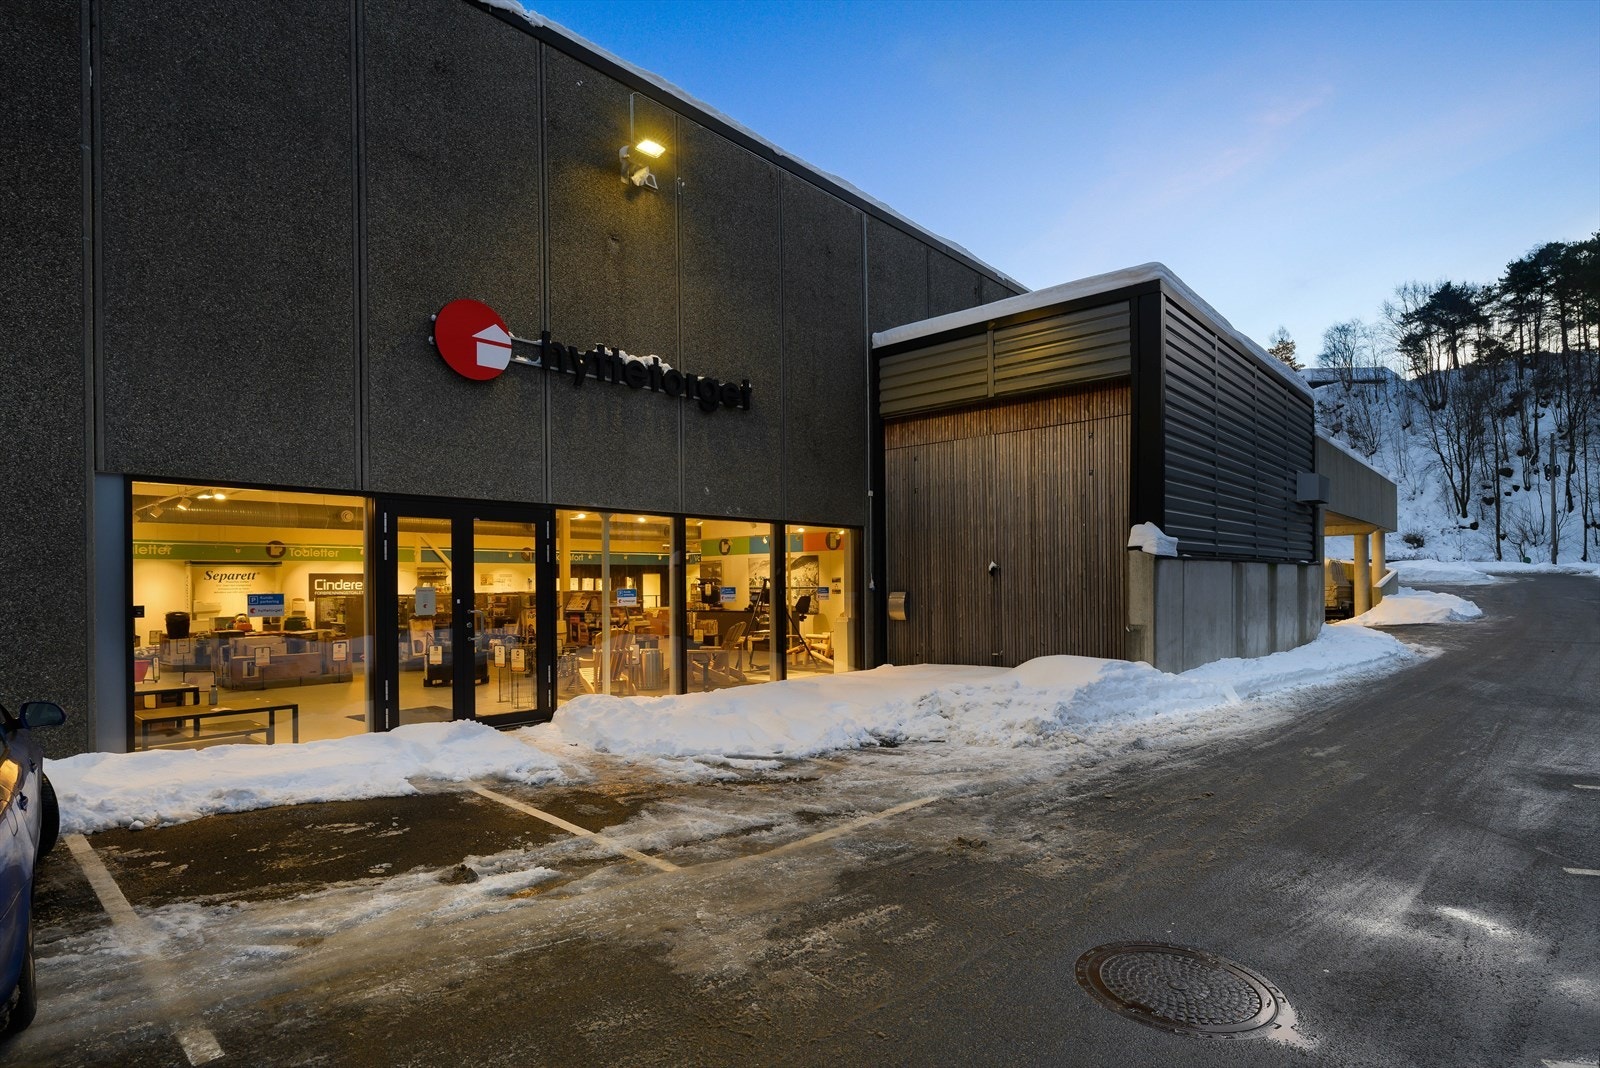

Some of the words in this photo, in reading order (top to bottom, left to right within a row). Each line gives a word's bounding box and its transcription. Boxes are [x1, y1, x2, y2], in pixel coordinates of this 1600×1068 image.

[541, 330, 752, 413] hyttetorget
[289, 547, 339, 558] Toaletter
[203, 570, 257, 583] Separett
[314, 578, 363, 590] Cindere
